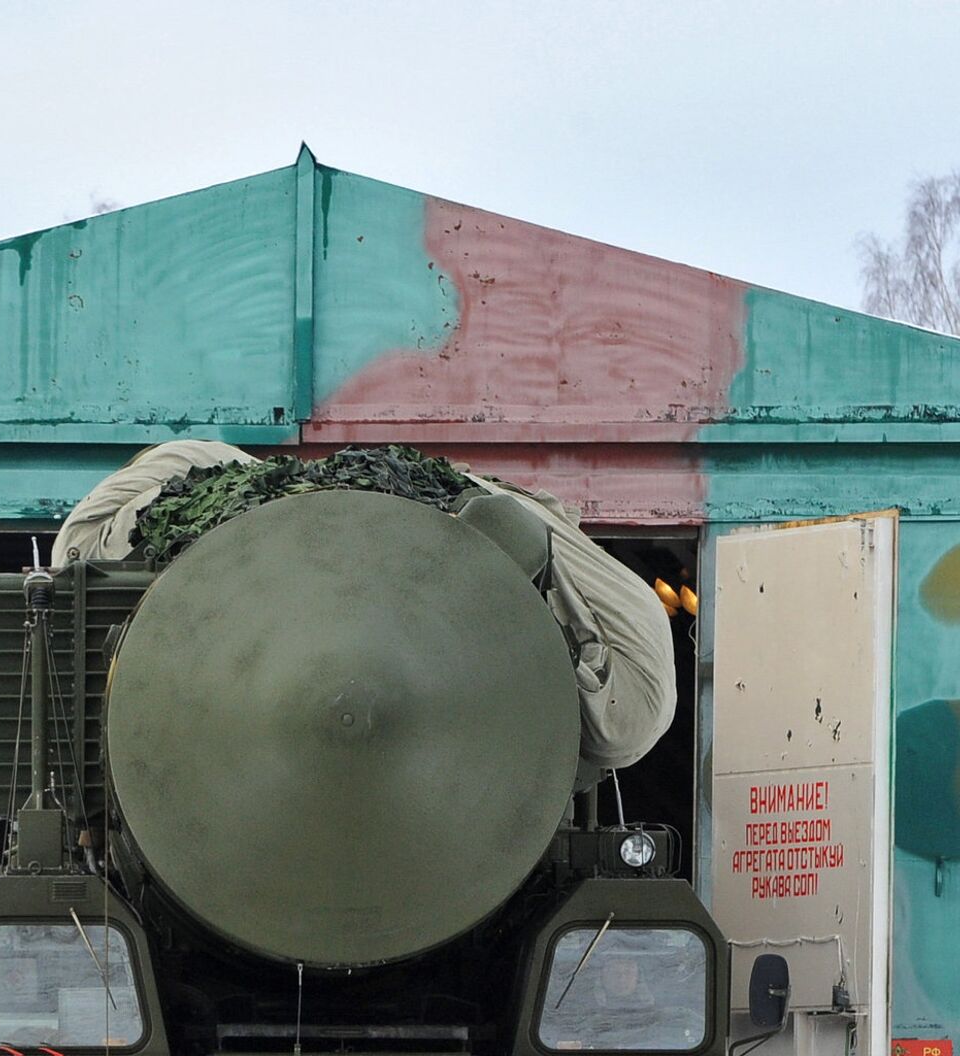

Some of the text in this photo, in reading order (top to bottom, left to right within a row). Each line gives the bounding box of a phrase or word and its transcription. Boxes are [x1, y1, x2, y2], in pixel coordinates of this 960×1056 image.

[750, 781, 830, 815] ВНИМАНИЕ!
[745, 818, 831, 846] ПЕРЕД ВЫЕЗДОМ
[732, 843, 844, 873] АГРЕГАТА ОТСТЫКУЙ
[751, 874, 791, 900] РУКАВА
[923, 1047, 941, 1056] РФ
